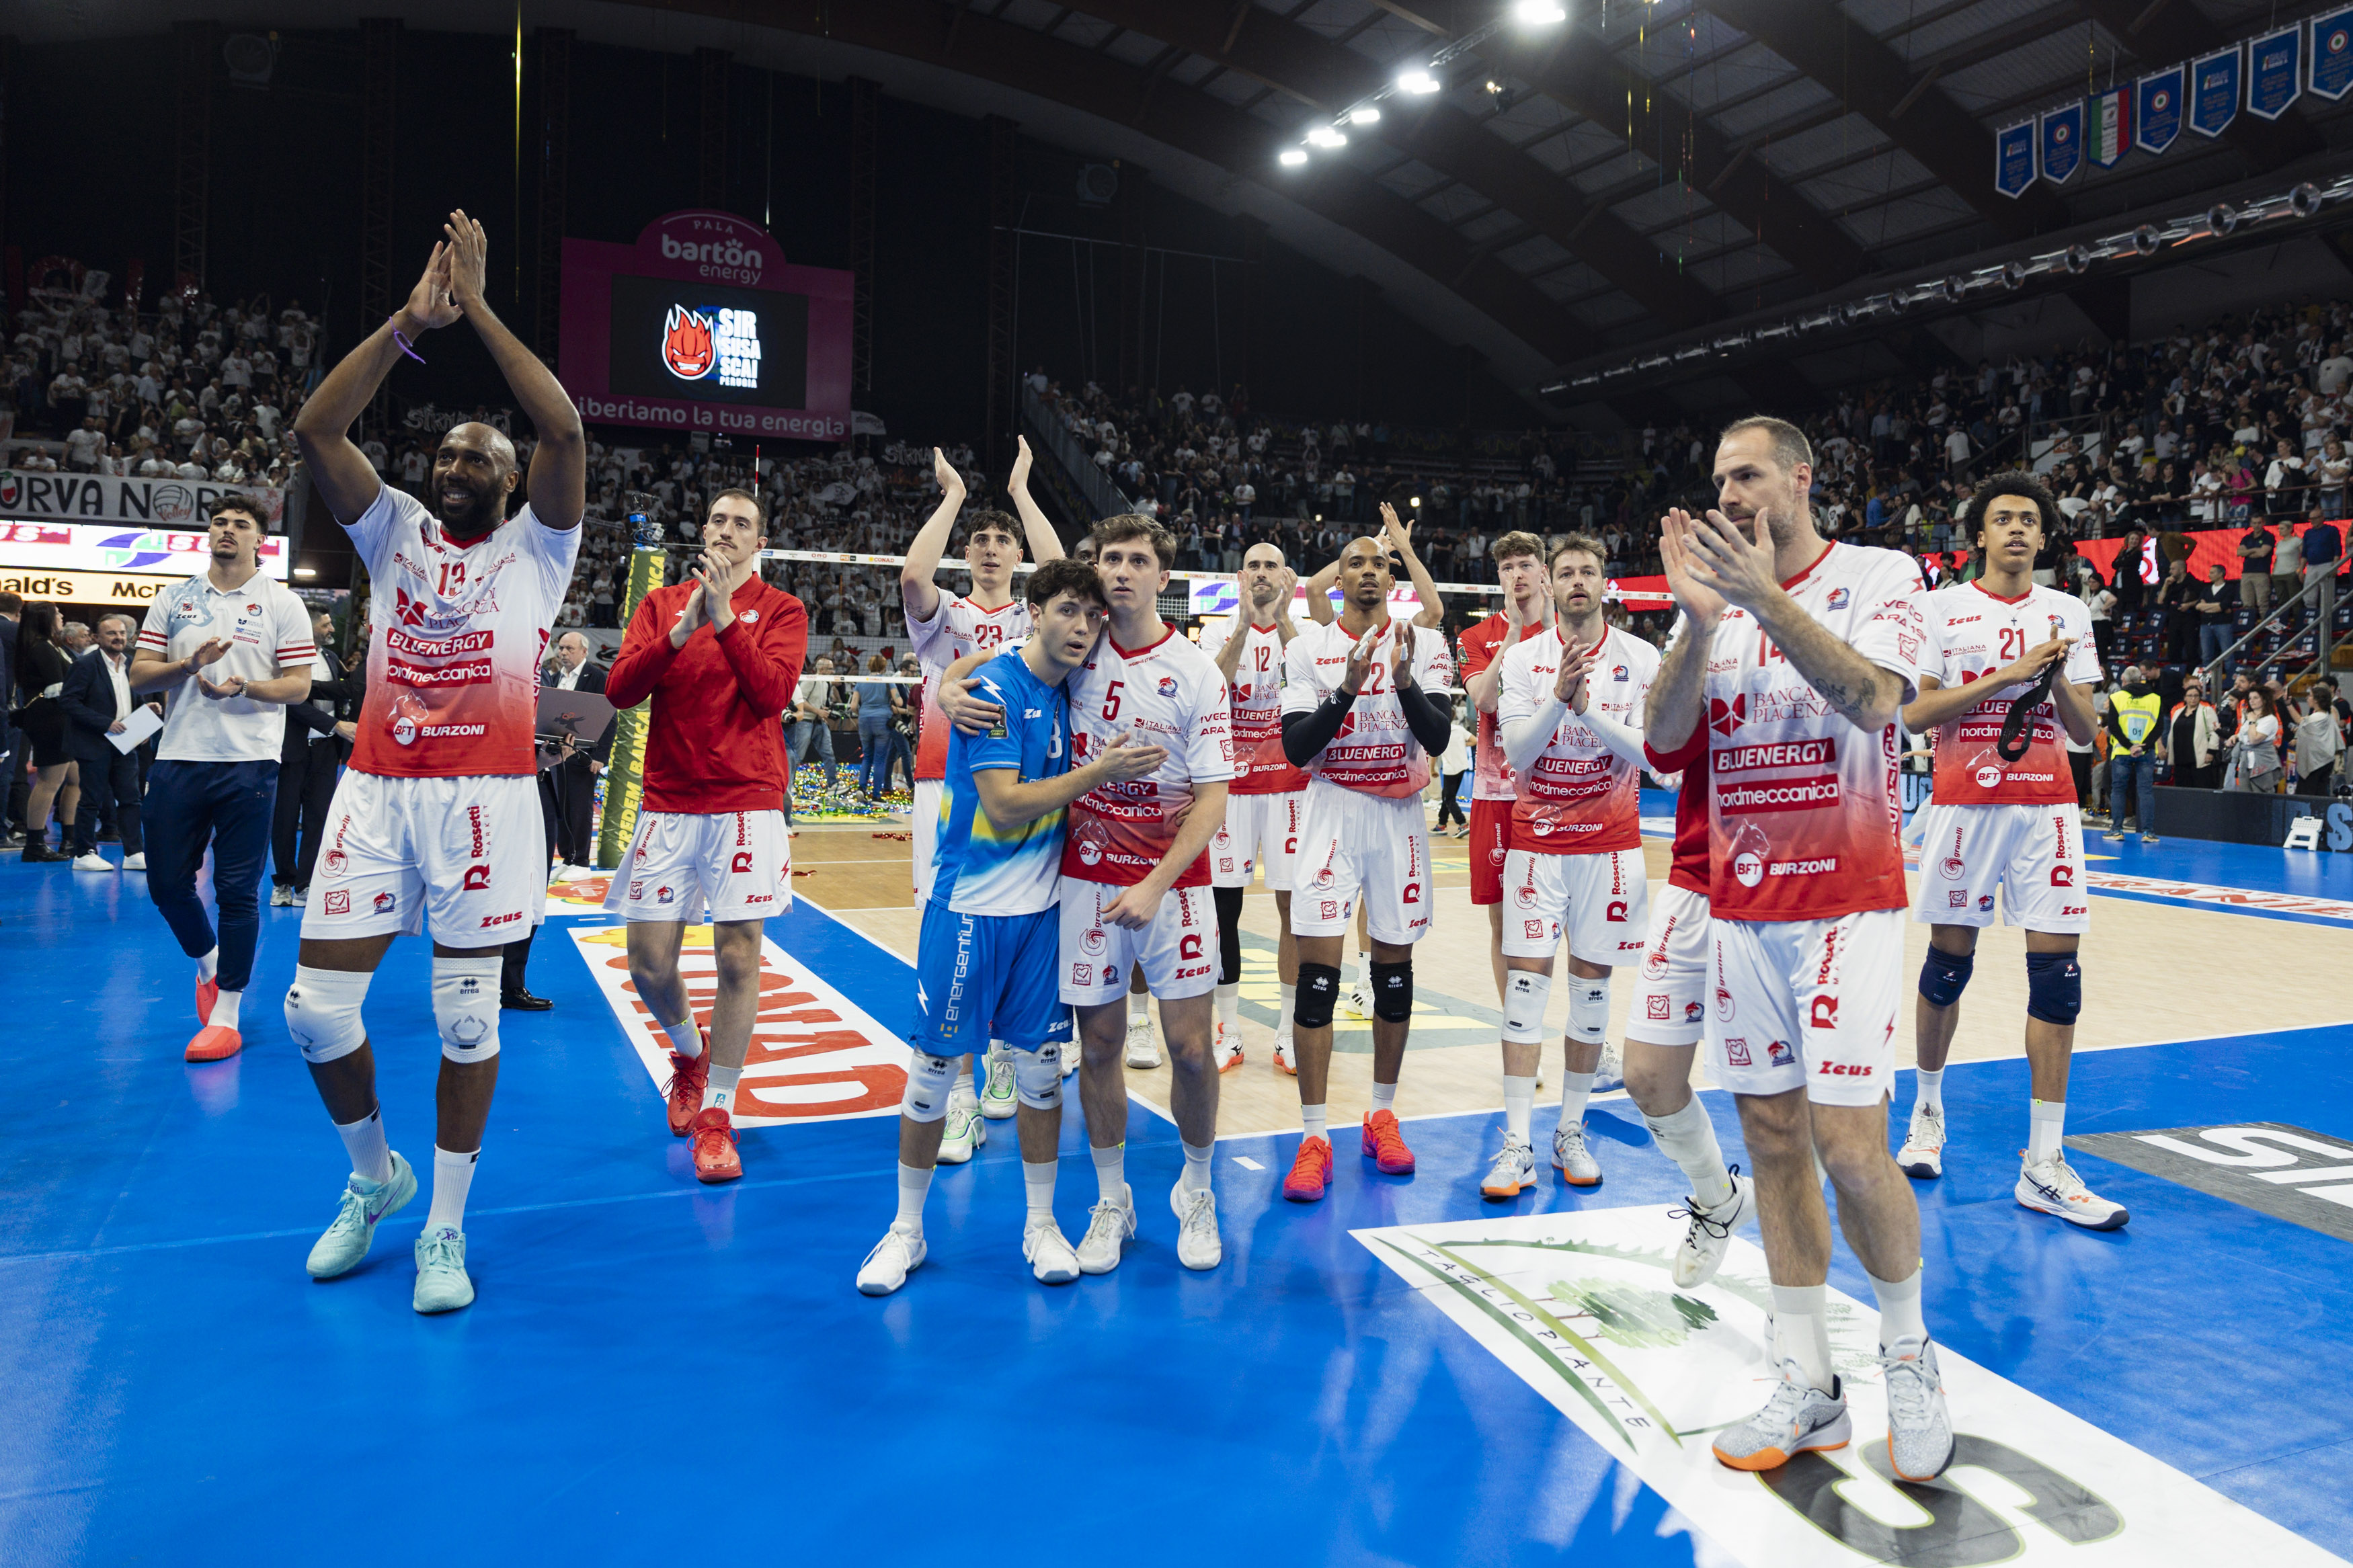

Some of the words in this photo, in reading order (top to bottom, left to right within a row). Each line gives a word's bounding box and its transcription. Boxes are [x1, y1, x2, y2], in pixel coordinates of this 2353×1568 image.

[694, 220, 733, 234] PALA
[699, 265, 761, 285] energy
[718, 308, 757, 339] SIR
[721, 337, 761, 360] SUSA
[720, 358, 758, 379] SCAI
[719, 376, 758, 388] PERUGIA
[579, 397, 687, 423] iberiamo
[693, 406, 713, 425] la
[720, 409, 756, 429] tua
[761, 413, 845, 438] energia
[438, 562, 465, 597] 13
[1875, 599, 1923, 623] VECO
[1872, 614, 1907, 628] ARA
[1947, 615, 1982, 626] Zeus
[975, 624, 1003, 650] 23
[1999, 628, 2026, 660] 21
[1952, 645, 1986, 653] ITALIANA
[1254, 647, 1271, 671] 12
[1315, 656, 1346, 665] Zeus
[388, 663, 491, 682] ordmeccanica
[1102, 680, 1124, 721] 5
[1254, 691, 1281, 701] PIACE
[1753, 687, 1817, 708] BANCA
[1359, 710, 1396, 721] BANCA
[1752, 701, 1841, 724] PIACENZ
[421, 724, 485, 737] BURZONI
[1146, 720, 1182, 732] ITALIANA
[1200, 726, 1226, 736] ARA
[1359, 719, 1410, 732] PIACENZ
[2132, 728, 2142, 737] 01
[629, 711, 651, 776] BANCA
[1327, 745, 1406, 761] BLUENERGY
[1718, 741, 1828, 770] BLUENERGY
[1252, 763, 1287, 772] BURZONI
[1538, 757, 1609, 774] BLUENERGY
[1321, 768, 1407, 782] nordmeccanica
[2006, 773, 2053, 782] BURZONI
[1529, 780, 1611, 796] nordmeccanica
[1718, 781, 1838, 807] nordmeccanica
[617, 781, 641, 853] CREDEM
[336, 815, 350, 849] granelli
[467, 805, 484, 858] Rossetti
[641, 820, 657, 848] granelli
[736, 811, 745, 846] Rosset
[1534, 823, 1554, 831] BFT
[1556, 823, 1603, 832] BURZONI
[1954, 827, 1963, 858] granelli
[2052, 817, 2066, 859] Rossetti
[1080, 846, 1101, 857] BFT
[1107, 853, 1160, 866] BURZONI
[1408, 835, 1416, 877] Rossetti
[1527, 856, 1536, 886] granelli
[1611, 852, 1621, 895] Rossetti
[1738, 864, 1760, 875] BFT
[1769, 859, 1837, 875] BURZONI
[745, 894, 773, 903] Zeus
[1190, 893, 1200, 925] MARK
[479, 911, 522, 928] Zeus
[1659, 915, 1677, 952] granelli
[1617, 941, 1645, 950] Zeus
[1174, 964, 1211, 980] Zeus
[1717, 940, 1725, 987] granelli
[1819, 1061, 1872, 1077] Zeus
